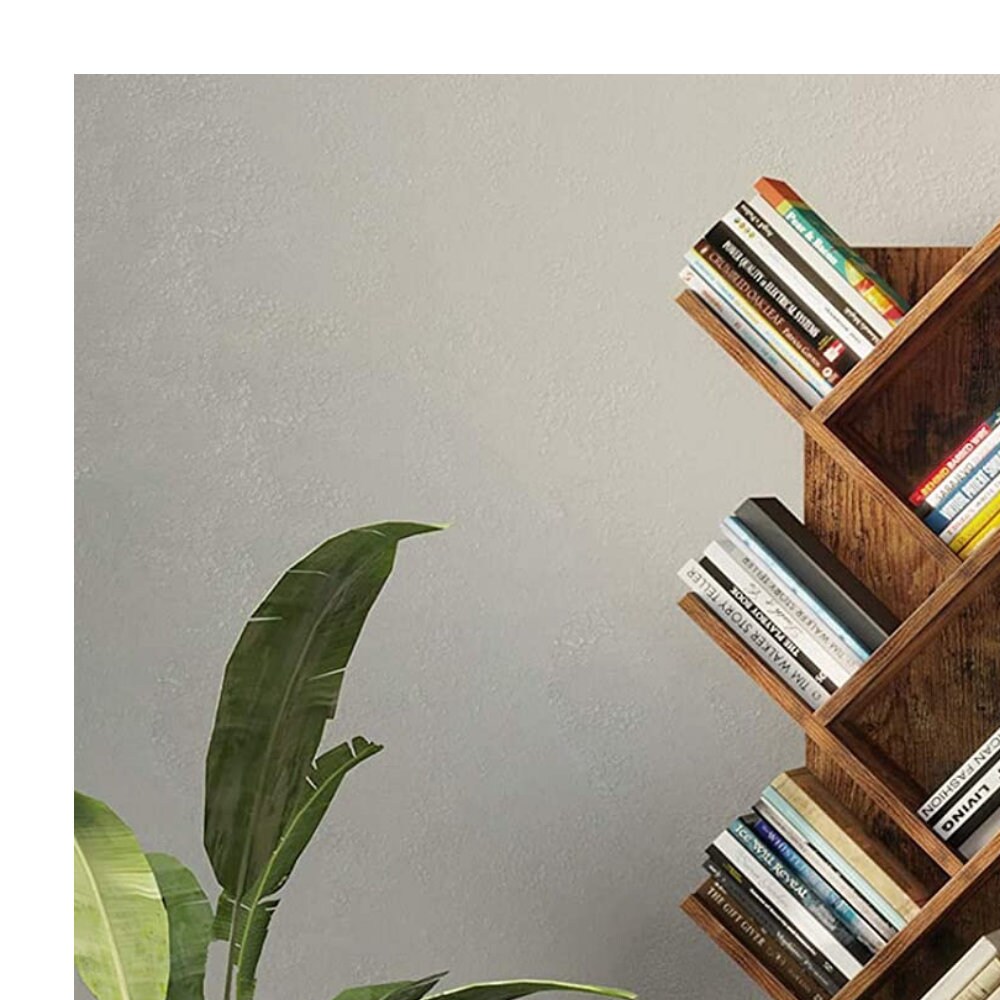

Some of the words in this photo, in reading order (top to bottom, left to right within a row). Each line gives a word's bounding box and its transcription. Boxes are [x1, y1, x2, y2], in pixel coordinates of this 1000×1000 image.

[684, 566, 721, 602] TELLER
[728, 585, 753, 609] BOOK
[716, 597, 754, 633] STORY
[749, 605, 786, 641] PLAYBOY
[748, 629, 794, 673] WALKER
[781, 637, 801, 657] THE
[789, 669, 811, 691] TIM
[920, 763, 974, 817] FASHION
[940, 783, 990, 833] LIVING
[704, 885, 725, 906] THE
[720, 902, 743, 924] GIFT
